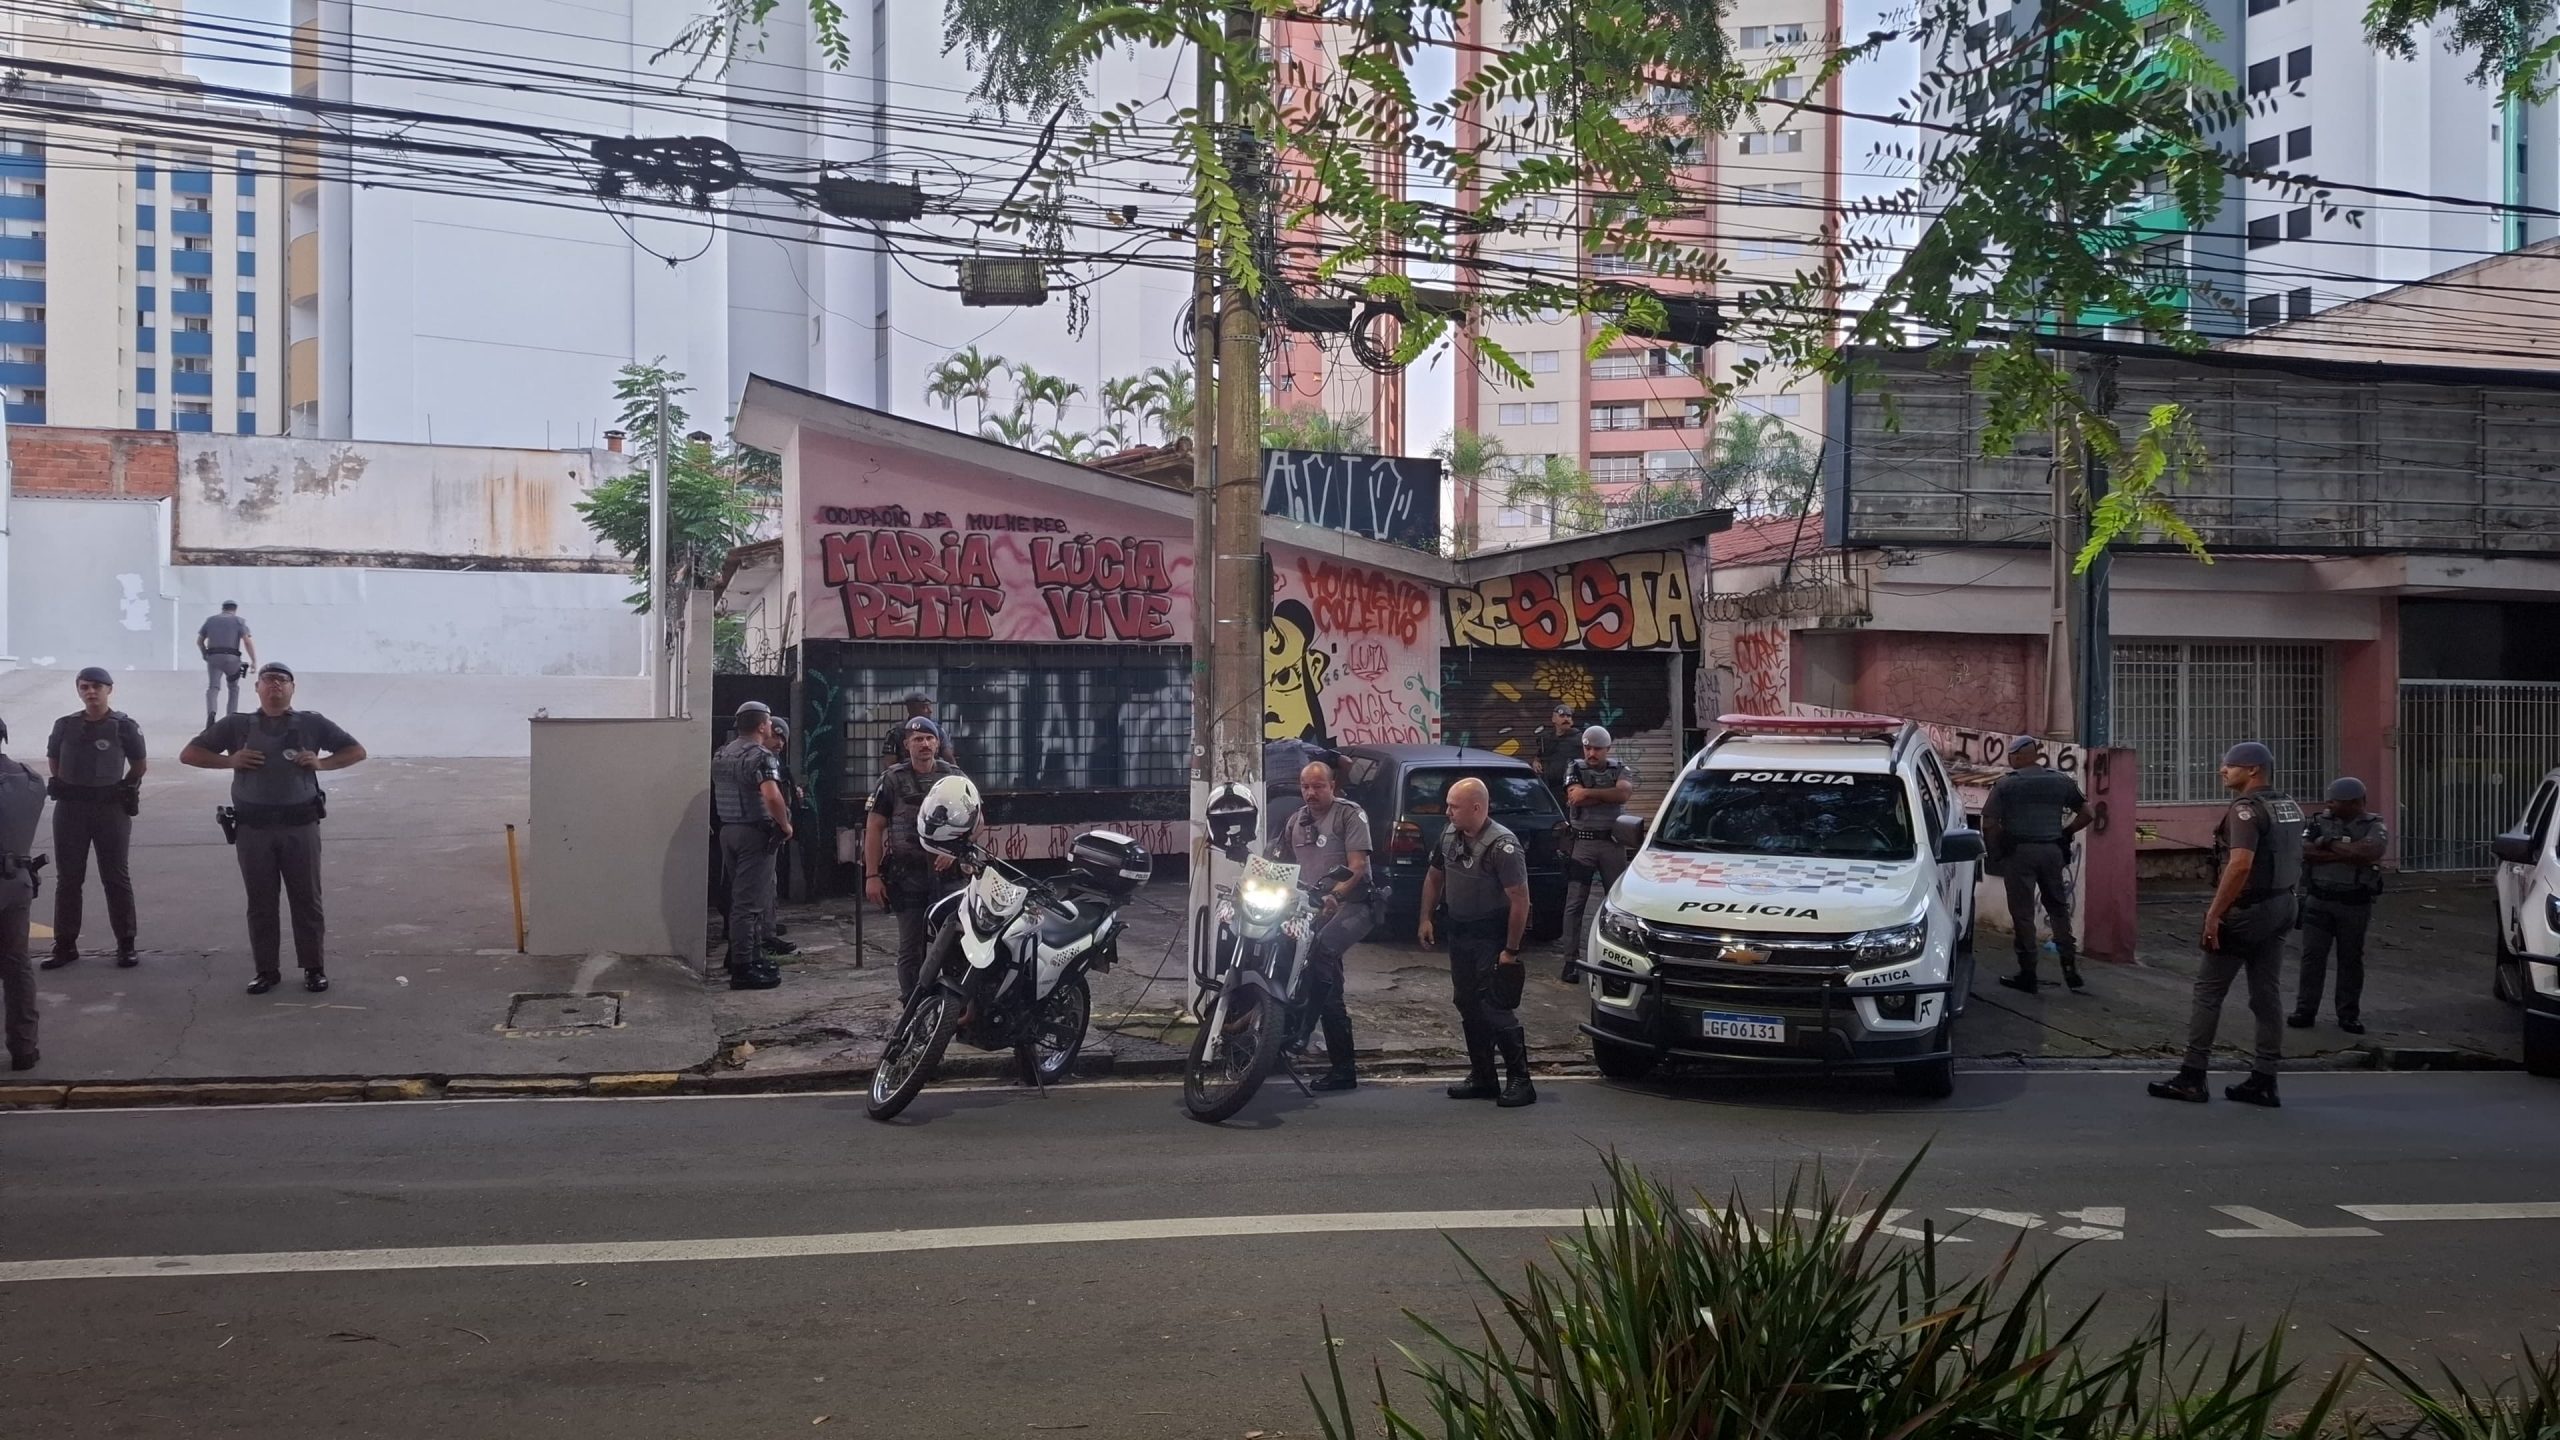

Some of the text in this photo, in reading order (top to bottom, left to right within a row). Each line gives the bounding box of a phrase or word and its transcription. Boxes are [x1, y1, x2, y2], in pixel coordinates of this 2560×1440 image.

[923, 511, 947, 527] DE
[1350, 643, 1390, 674] LUTA
[1345, 693, 1393, 725] OLGA
[1729, 771, 1856, 786] POLÍCIA
[1677, 901, 1819, 921] POLÍCIA
[1602, 948, 1633, 967] FORÇA
[1862, 969, 1911, 986] TÁTICA
